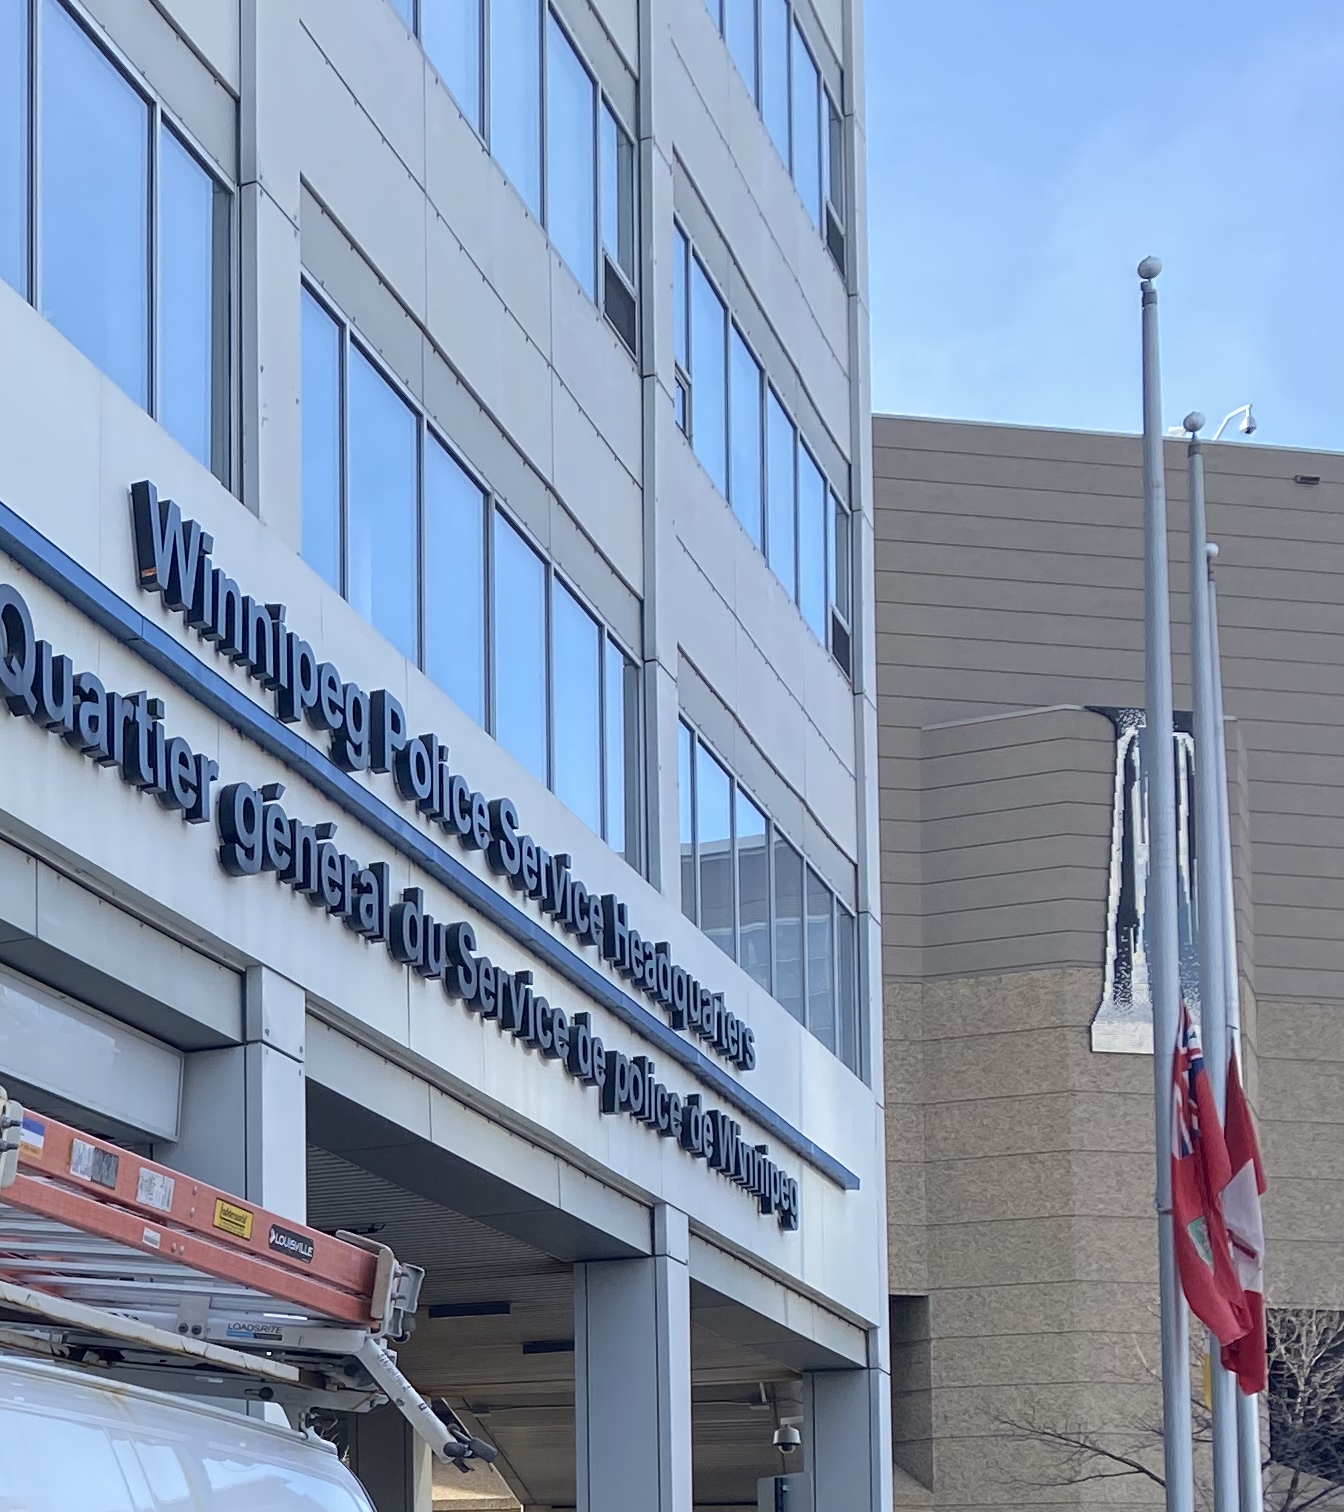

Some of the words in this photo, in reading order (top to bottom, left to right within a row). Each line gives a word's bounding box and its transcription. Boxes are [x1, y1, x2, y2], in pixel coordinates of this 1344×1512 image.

[131, 480, 369, 771] Winnipeg
[370, 689, 491, 850] Police
[486, 798, 604, 945] Service
[601, 894, 756, 1070] Headquarters
[219, 781, 389, 942] général
[389, 887, 447, 980] du
[445, 922, 570, 1059] Service
[568, 1012, 606, 1086] de
[603, 1050, 682, 1137] police
[681, 1094, 713, 1158] de
[707, 1109, 798, 1231] Winnipeg
[274, 1232, 314, 1257] LOUISVILLE
